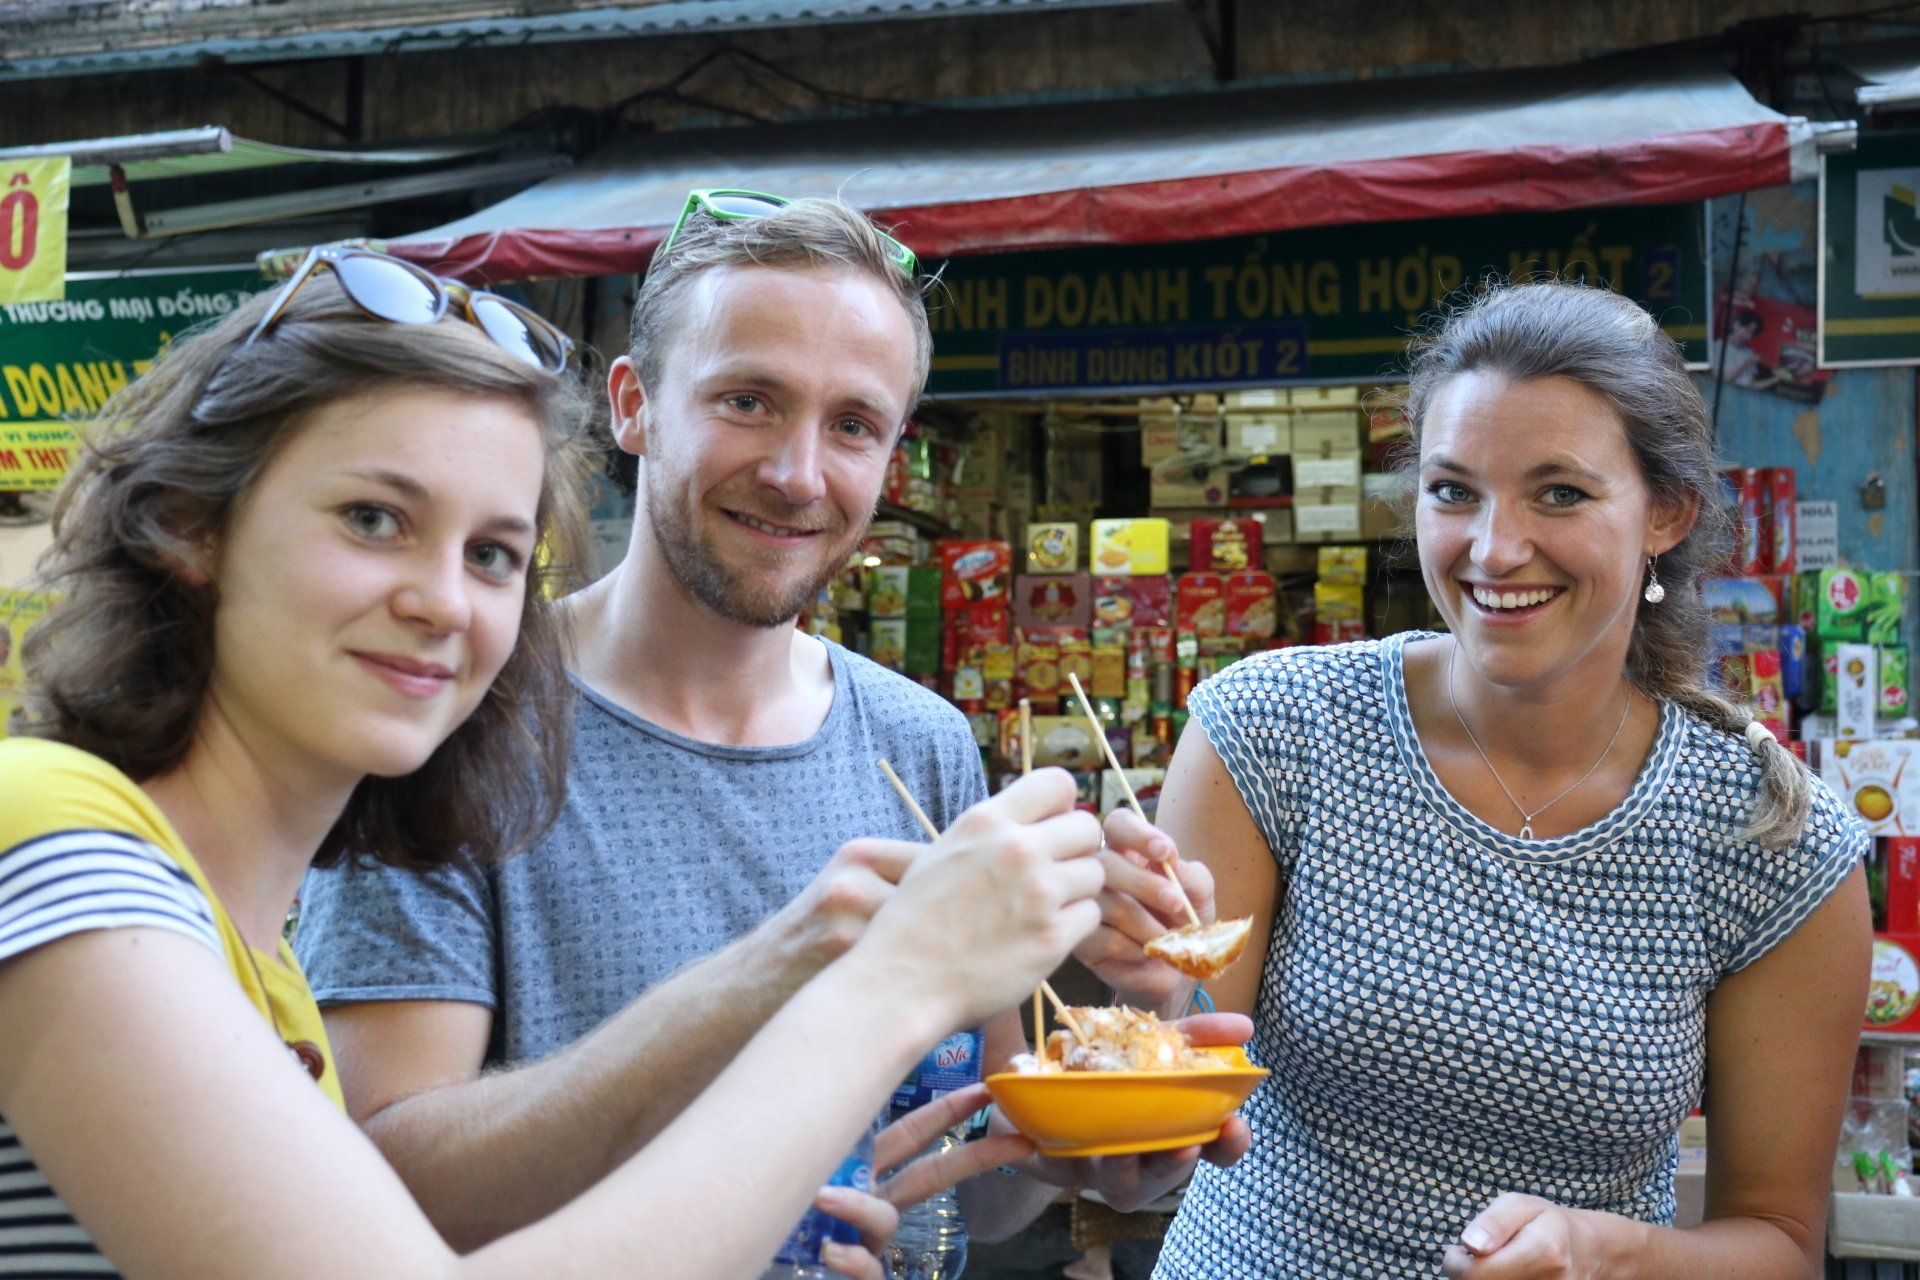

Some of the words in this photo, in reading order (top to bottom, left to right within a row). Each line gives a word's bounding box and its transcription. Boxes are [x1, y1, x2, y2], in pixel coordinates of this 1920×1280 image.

[1024, 269, 1189, 328] DOANH
[1205, 236, 1342, 319] TỔNG
[1358, 244, 1463, 326] HỢP
[1648, 260, 1674, 299] 2
[1007, 343, 1078, 385] BÌNH
[1174, 326, 1263, 378] KIỐT
[1275, 340, 1300, 375] 2
[3, 361, 130, 418] DOANH
